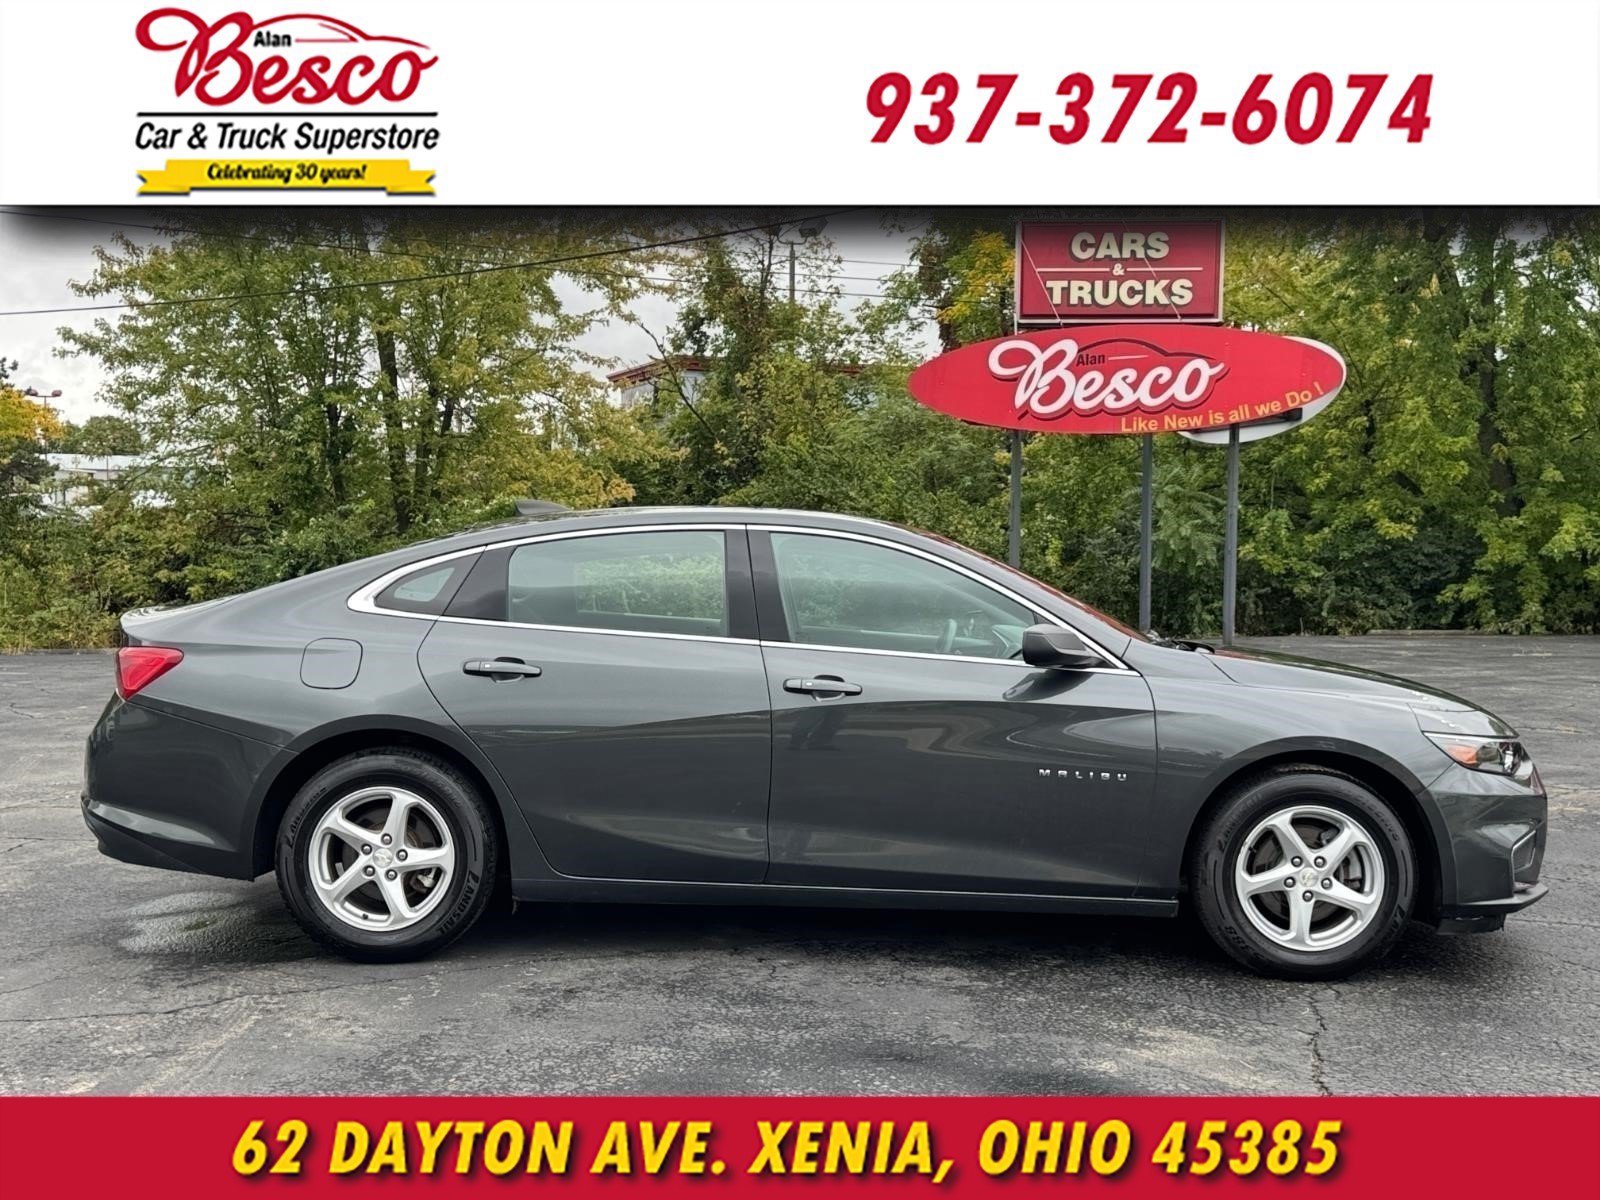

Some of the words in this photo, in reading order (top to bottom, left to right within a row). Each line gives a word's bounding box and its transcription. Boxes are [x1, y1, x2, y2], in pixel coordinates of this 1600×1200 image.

[1071, 232, 1170, 260] CARS
[1112, 262, 1125, 276] &
[1046, 279, 1193, 306] TRUCKS
[1076, 352, 1106, 367] Alan
[988, 339, 1225, 414] Besco
[1121, 416, 1158, 433] Like
[1164, 414, 1203, 430] New
[1209, 410, 1223, 425] is
[1228, 406, 1250, 422] all
[1255, 400, 1281, 416] we
[1285, 389, 1313, 409] Do
[1039, 769, 1127, 781] MALIBU
